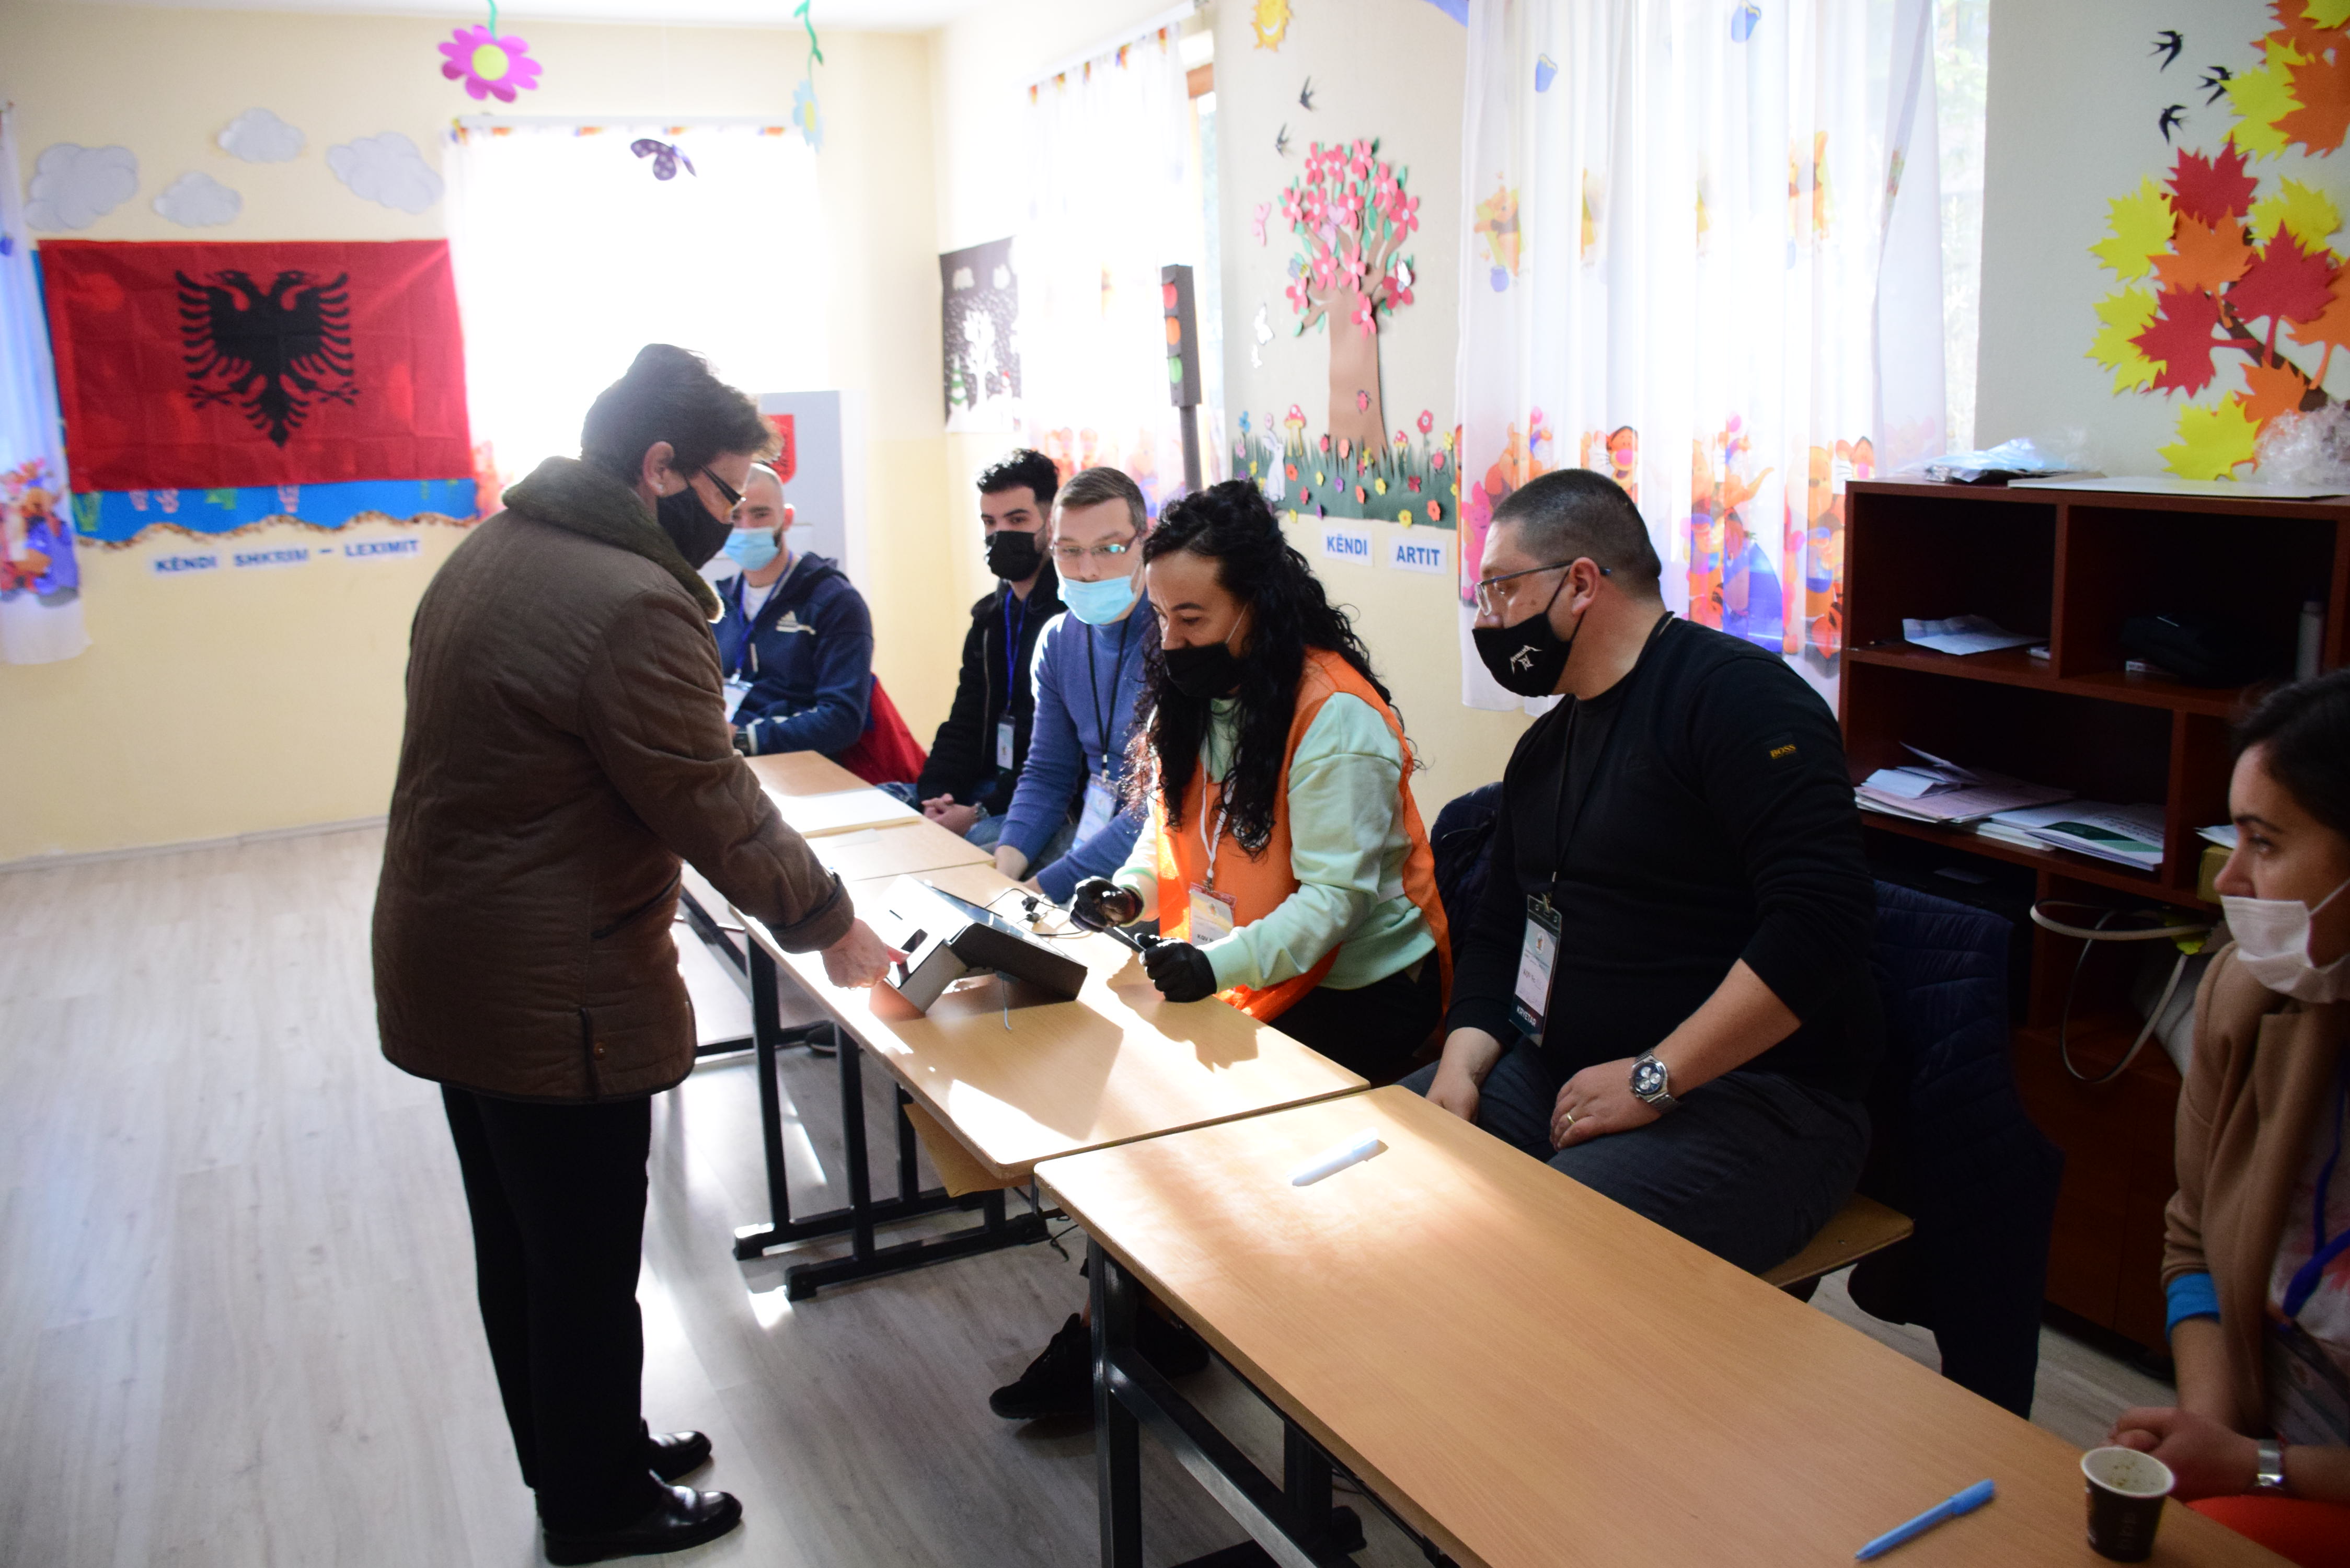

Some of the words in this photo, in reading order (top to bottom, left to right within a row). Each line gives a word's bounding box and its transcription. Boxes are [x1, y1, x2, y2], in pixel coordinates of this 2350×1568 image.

[156, 555, 216, 571] KËNDI
[345, 539, 419, 557] LEXIMIT
[1327, 534, 1367, 556] KËNDI
[1396, 545, 1440, 567] ARTIT
[1770, 744, 1796, 759] BOSS
[1516, 1006, 1536, 1027] KRYETAR
